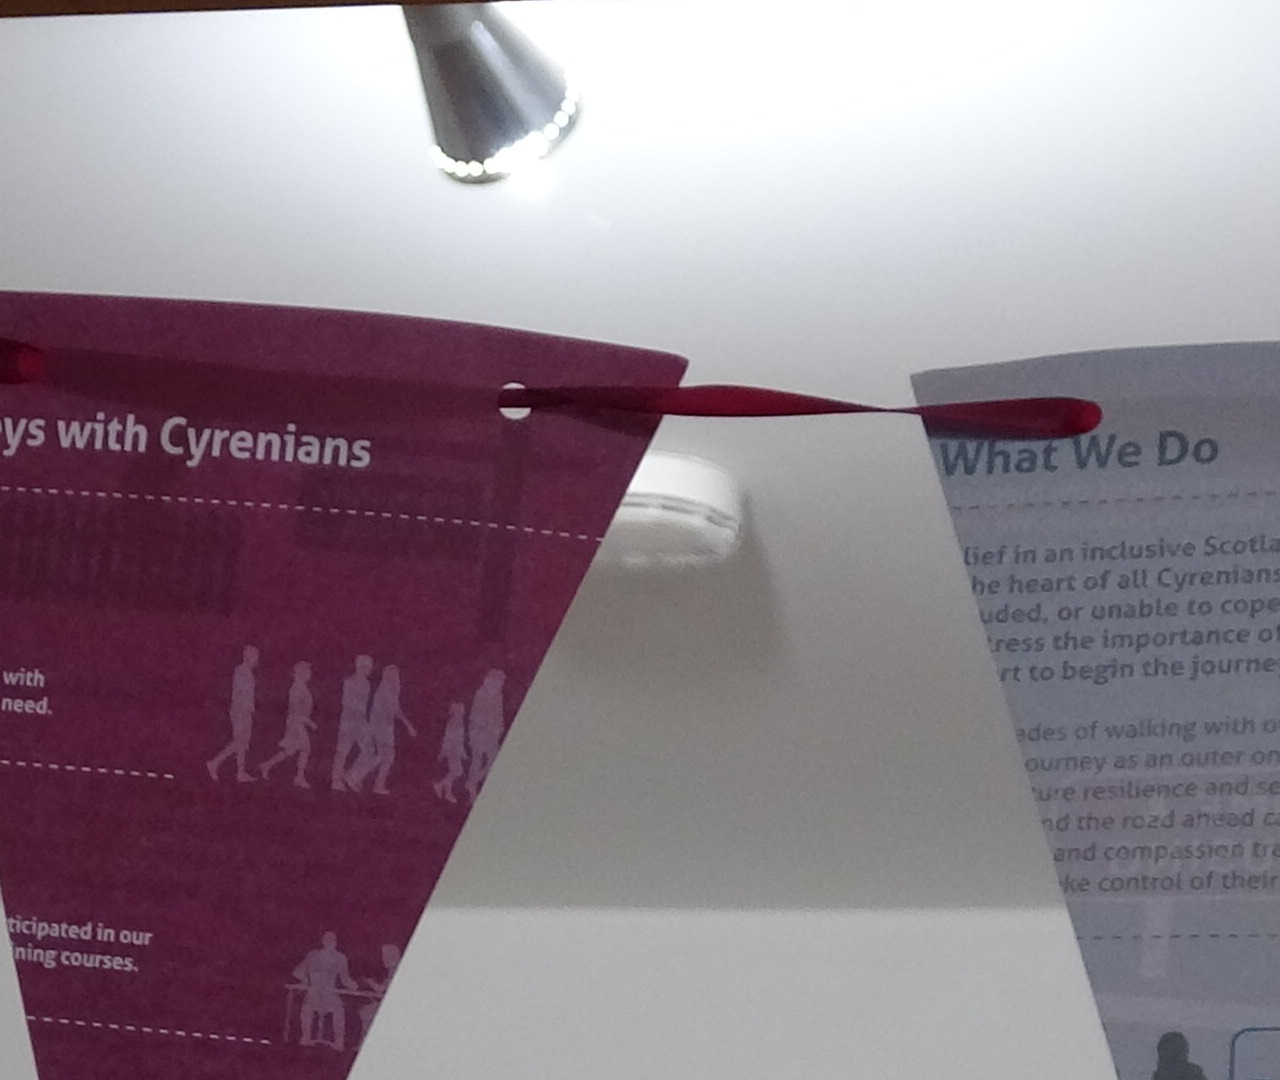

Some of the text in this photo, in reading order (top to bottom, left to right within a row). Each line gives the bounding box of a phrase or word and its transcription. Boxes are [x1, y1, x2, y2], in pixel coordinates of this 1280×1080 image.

[58, 411, 148, 454] with
[160, 417, 372, 468] Cyrenians
[940, 430, 1220, 476] What We Do
[1014, 541, 1038, 565] in
[1044, 545, 1074, 564] an
[1081, 537, 1197, 562] inclusive
[1008, 568, 1076, 594] heart
[1083, 566, 1111, 591] of
[1118, 567, 1148, 590] all
[1057, 605, 1083, 622] or
[1091, 597, 1178, 621] unable
[1187, 594, 1214, 617] to
[1053, 629, 1096, 651] the
[1102, 626, 1251, 653] importance
[3, 667, 45, 687] with
[1030, 661, 1055, 681] to
[1061, 659, 1134, 686] begin
[1143, 657, 1185, 678] the
[1, 697, 53, 715] need.
[1104, 719, 1198, 742] walking
[1204, 716, 1256, 736] with
[1083, 780, 1198, 801] resilience
[1206, 776, 1249, 796] and
[1098, 871, 1182, 892] control
[1189, 871, 1214, 890] of
[97, 923, 116, 943] in
[119, 930, 154, 946] our
[60, 951, 140, 972] courses.
